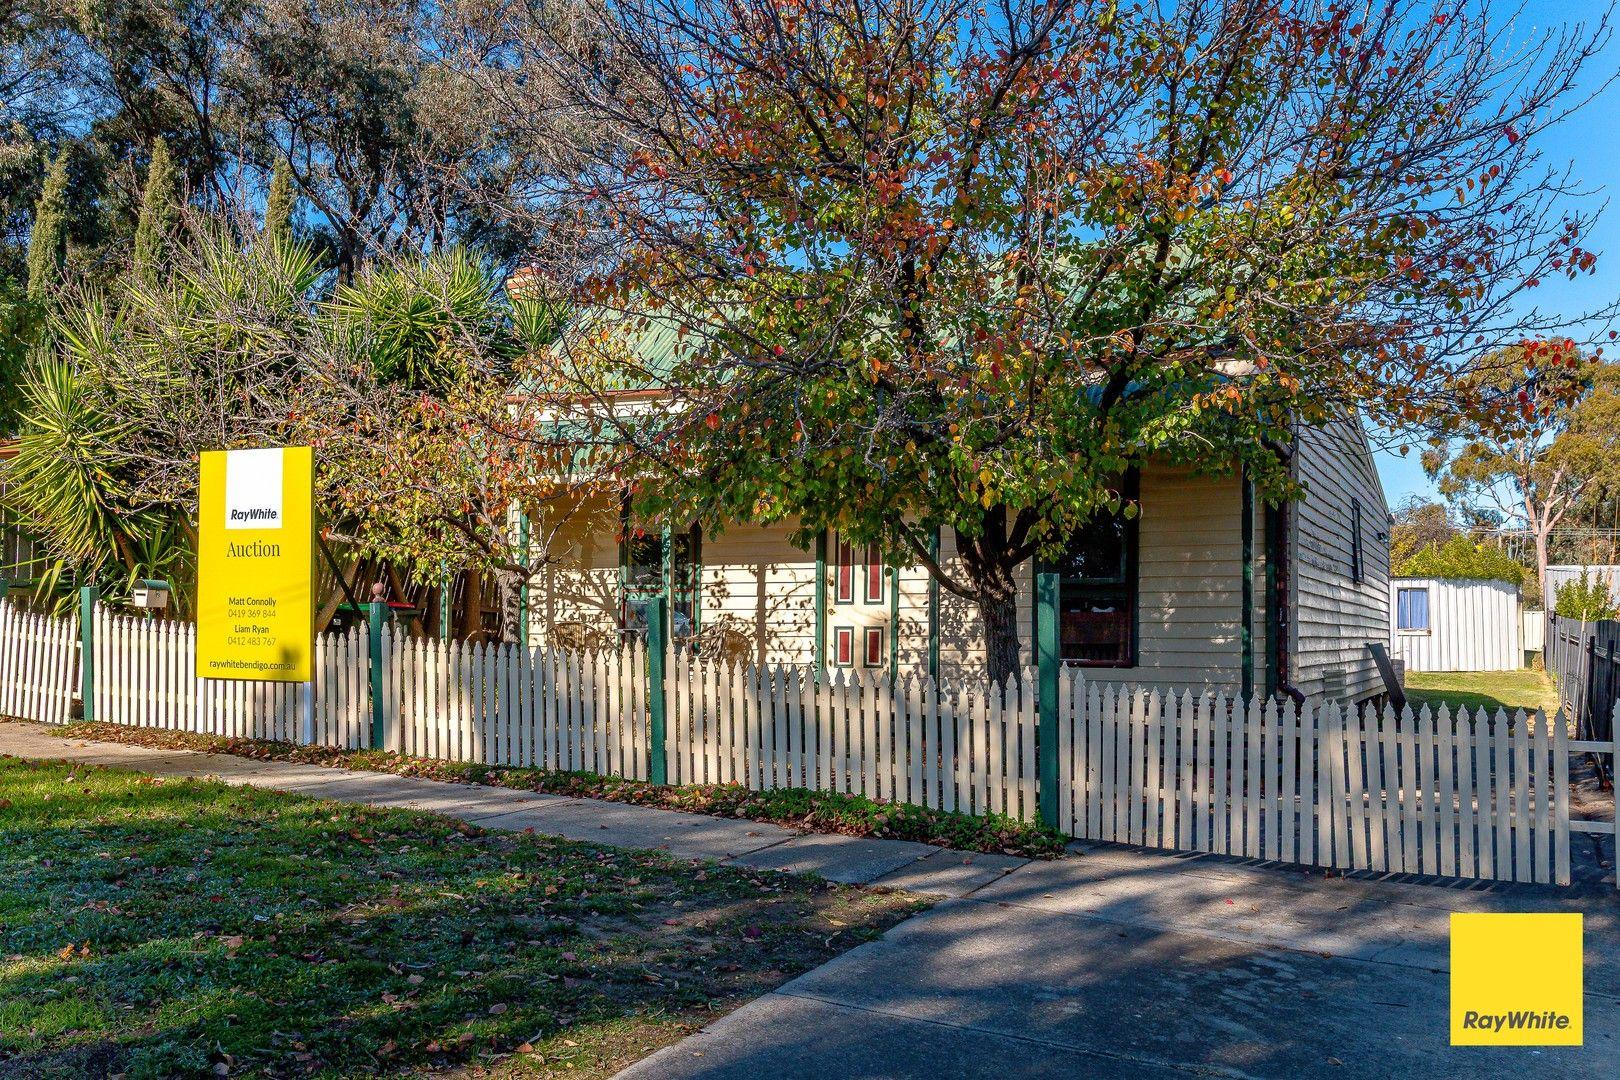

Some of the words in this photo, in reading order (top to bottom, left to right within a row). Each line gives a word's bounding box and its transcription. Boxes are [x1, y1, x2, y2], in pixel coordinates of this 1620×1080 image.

[226, 540, 280, 557] Auction
[228, 597, 245, 606] Matt
[246, 597, 277, 607] Connolly
[228, 609, 245, 618] 0419
[247, 609, 260, 618] 369
[262, 609, 276, 618] 844
[234, 625, 250, 633] Liam
[252, 625, 269, 635] Ryan
[227, 636, 246, 645] 0412
[247, 637, 260, 646] 483
[263, 637, 276, 646] 767
[209, 660, 296, 671] raywhitebendigo.com.au
